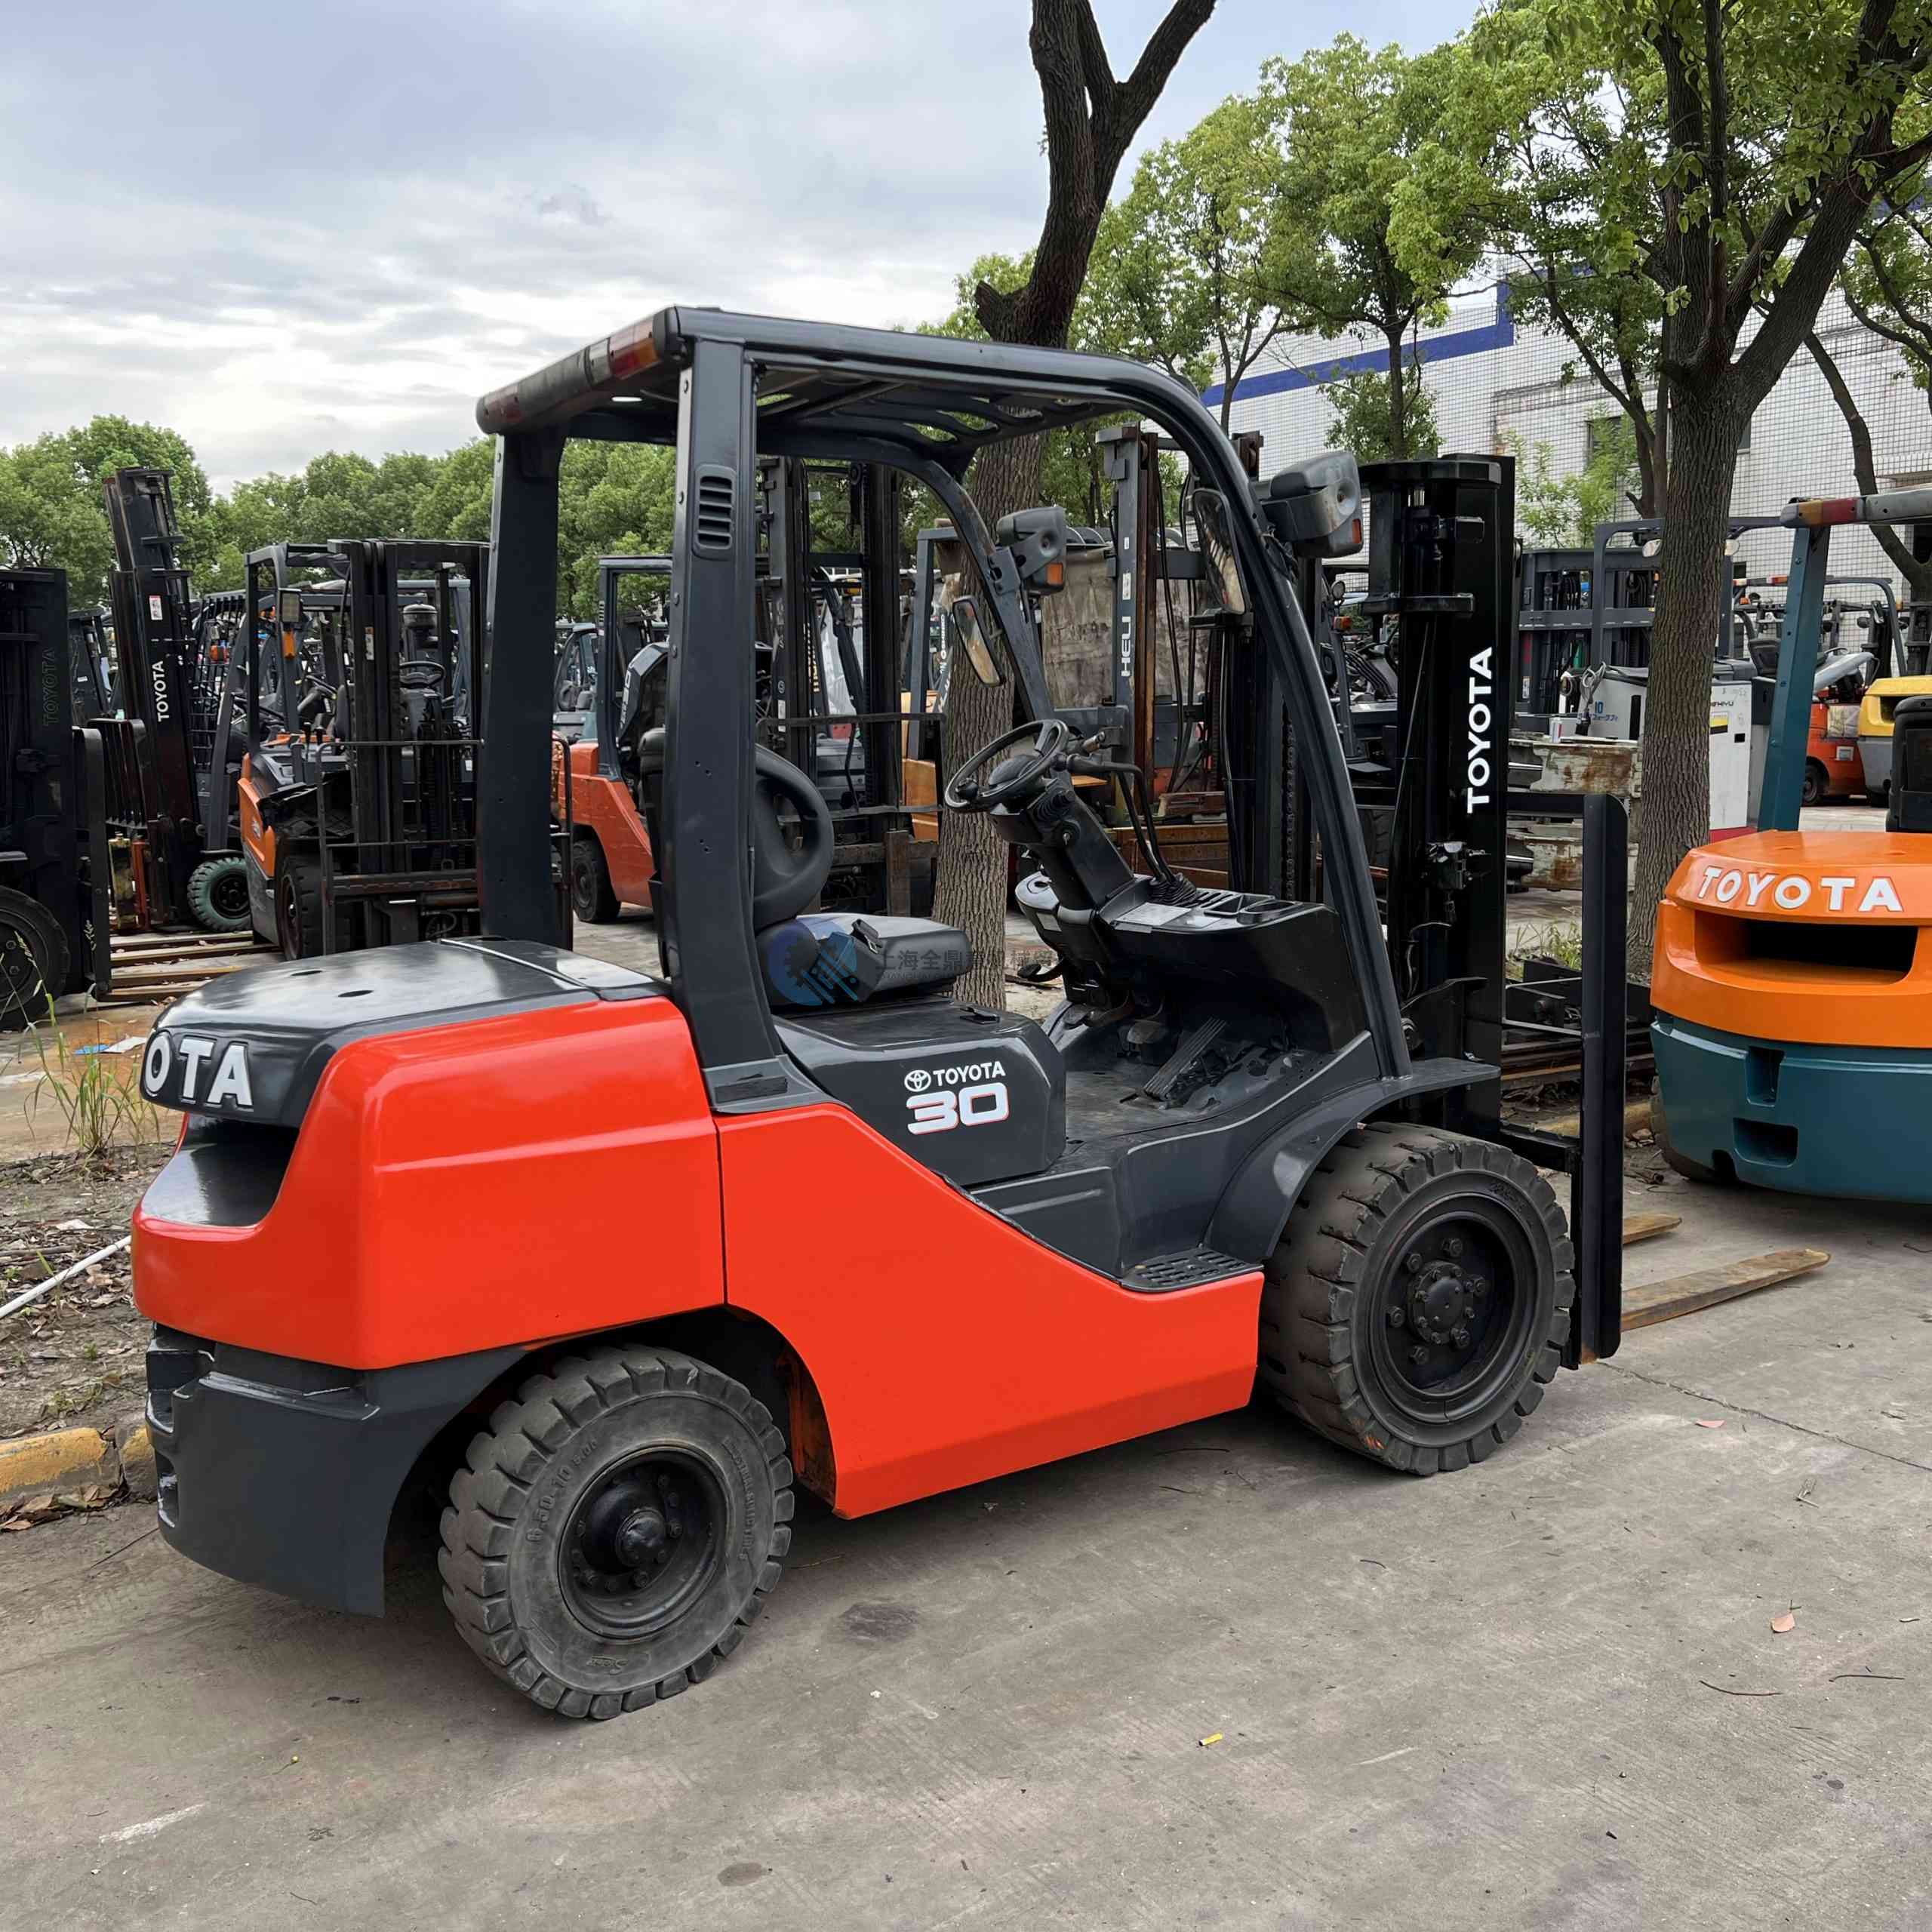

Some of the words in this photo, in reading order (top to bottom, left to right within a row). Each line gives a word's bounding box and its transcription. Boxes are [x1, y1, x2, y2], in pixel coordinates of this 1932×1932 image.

[43, 648, 58, 726] TOYOTA
[152, 661, 170, 721] TOYOTA
[1467, 647, 1493, 814] TOYOTA
[1698, 866, 1903, 912] TOYOTA
[146, 1033, 253, 1106] OTA
[934, 1061, 1005, 1086] TOYOTA
[906, 1083, 1009, 1134] 30
